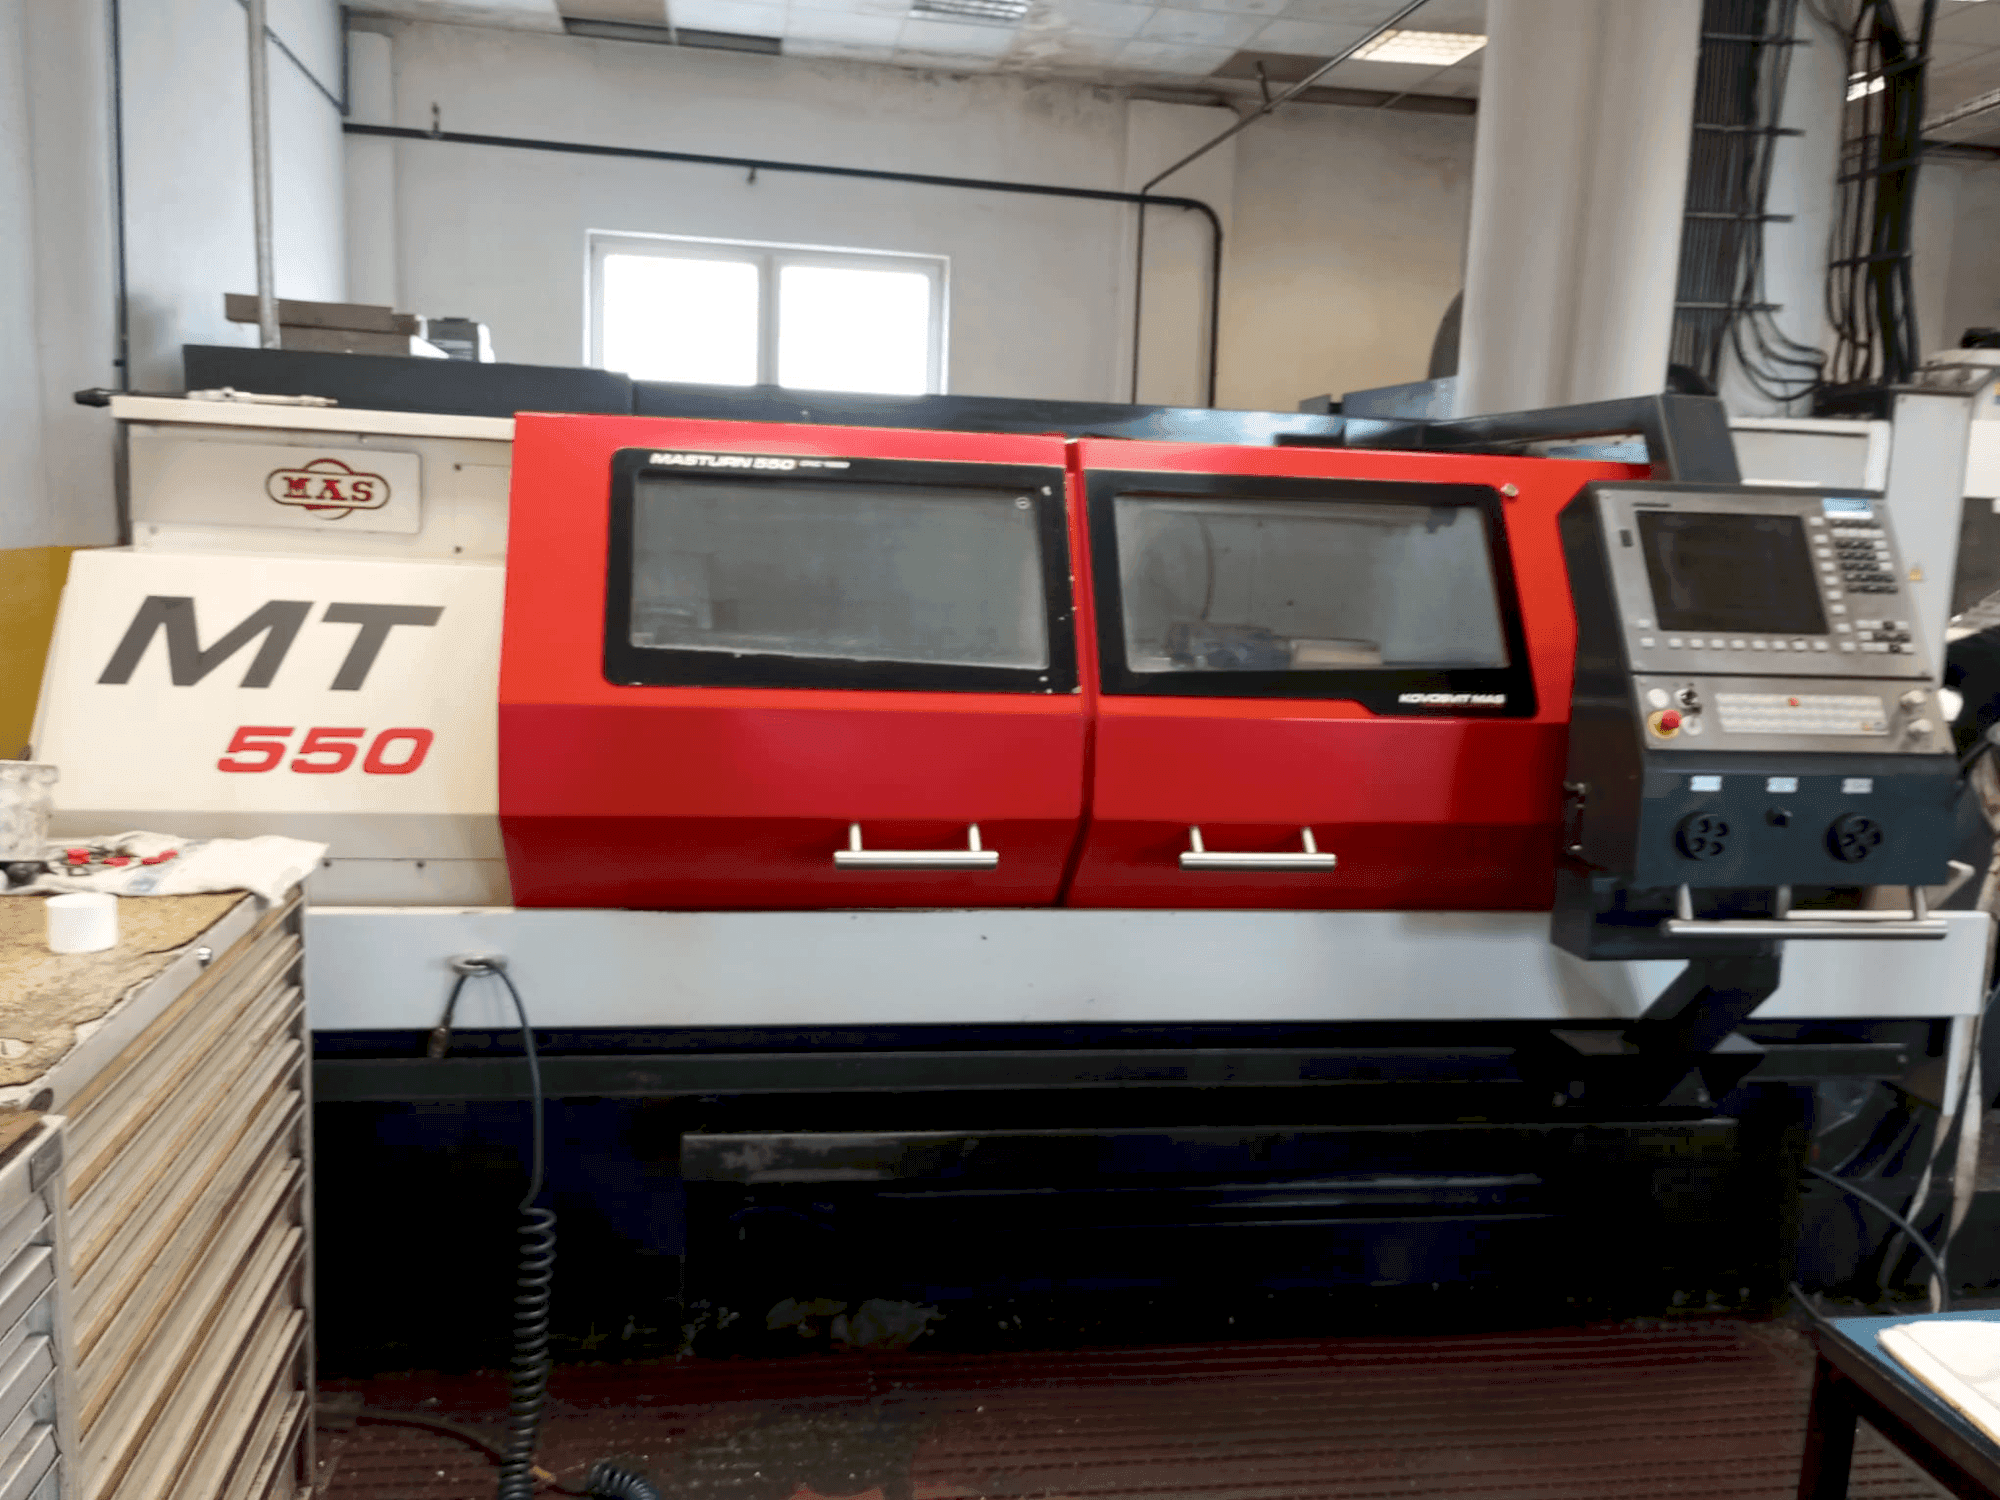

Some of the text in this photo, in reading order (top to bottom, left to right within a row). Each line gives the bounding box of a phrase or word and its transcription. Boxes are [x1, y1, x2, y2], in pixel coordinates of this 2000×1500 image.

[649, 453, 753, 468] MASTURN
[753, 457, 796, 470] 550
[282, 476, 374, 504] MAS
[97, 595, 446, 692] MT
[217, 725, 435, 775] 550
